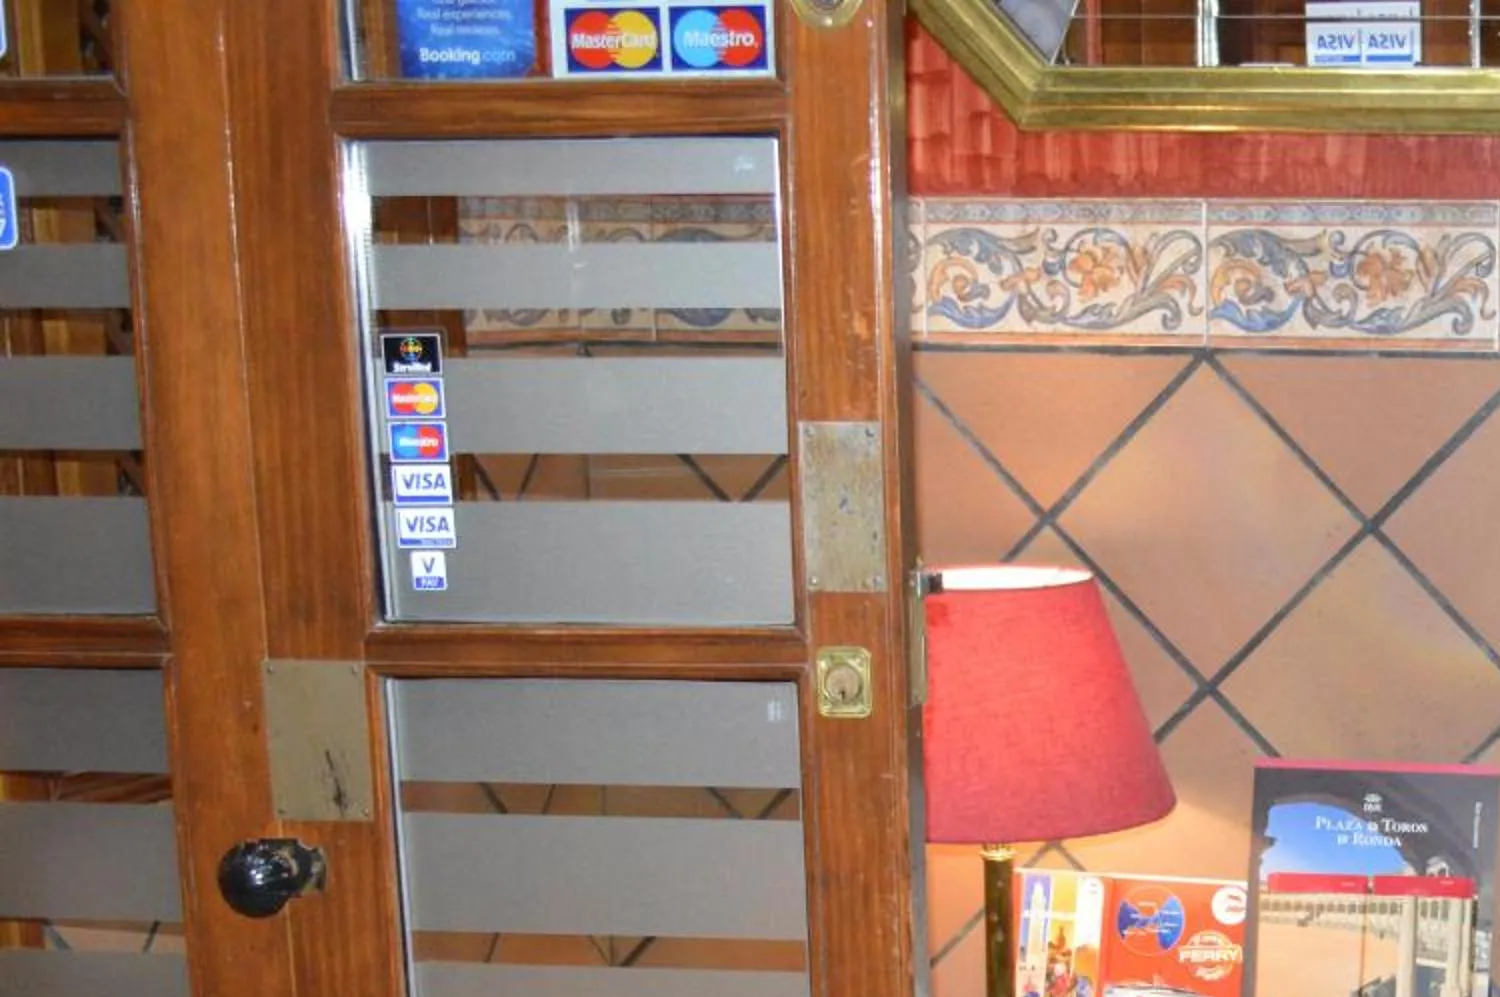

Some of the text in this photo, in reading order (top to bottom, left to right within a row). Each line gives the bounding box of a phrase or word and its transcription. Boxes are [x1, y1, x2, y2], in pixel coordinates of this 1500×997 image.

[571, 31, 658, 49] MasterCard
[683, 30, 755, 48] Maestro
[402, 473, 446, 490] VISA
[406, 515, 450, 533] VISA
[421, 557, 435, 573] V
[1315, 815, 1363, 831] PLAZA
[1381, 817, 1429, 833] TOROS
[1353, 833, 1402, 847] RONDA
